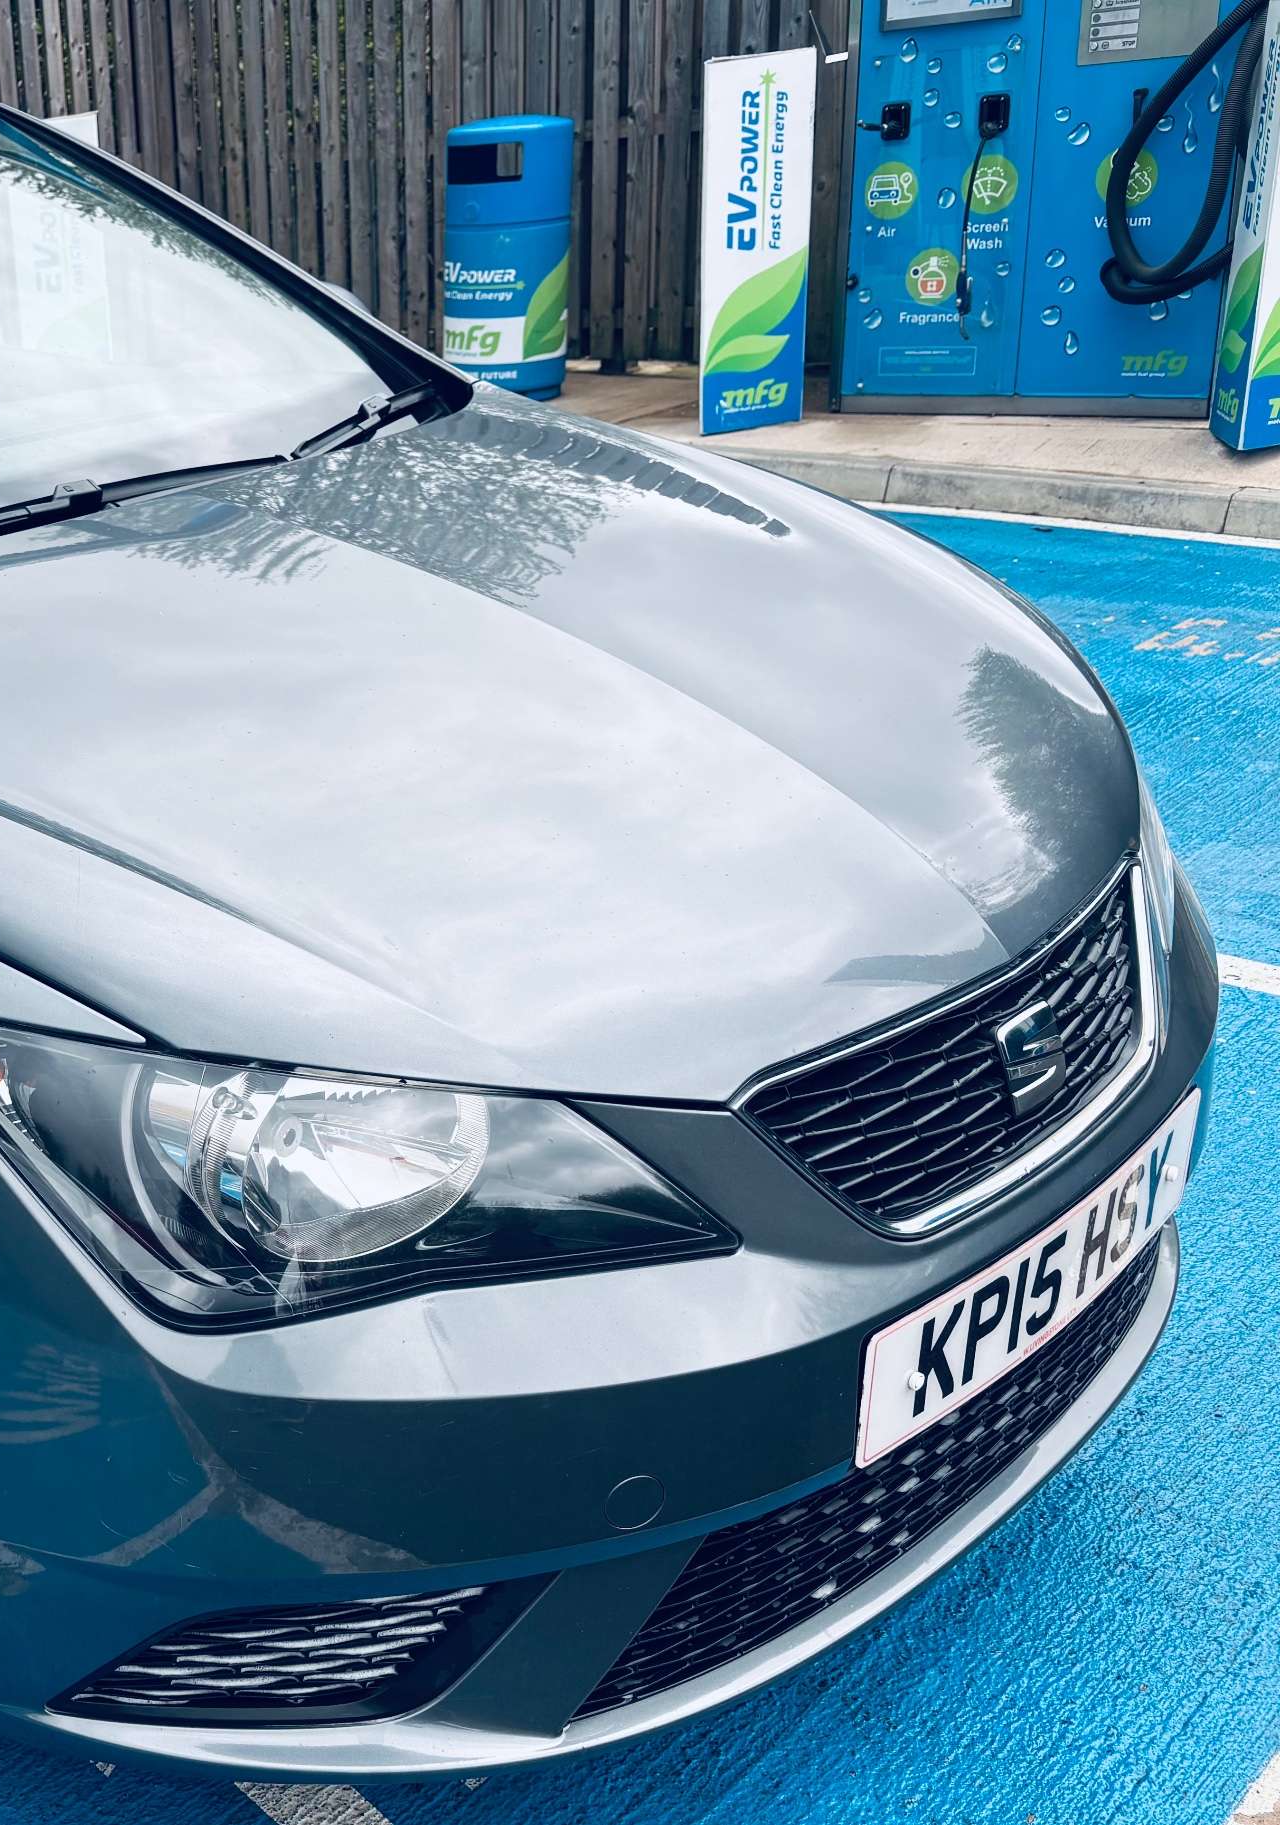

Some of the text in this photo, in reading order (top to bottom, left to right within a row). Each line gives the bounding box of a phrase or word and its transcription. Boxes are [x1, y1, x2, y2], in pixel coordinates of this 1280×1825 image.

[769, 90, 788, 249] Fast Clean Energy
[877, 226, 896, 238] Air
[967, 221, 1008, 233] Screen
[967, 237, 1003, 250] Wash
[475, 290, 514, 301] Energy
[899, 311, 960, 325] Fragrance
[1121, 350, 1188, 377] mfg
[481, 370, 518, 381] FUTURE
[722, 378, 789, 408] mfg
[913, 1130, 1175, 1418] KP15 HSY
